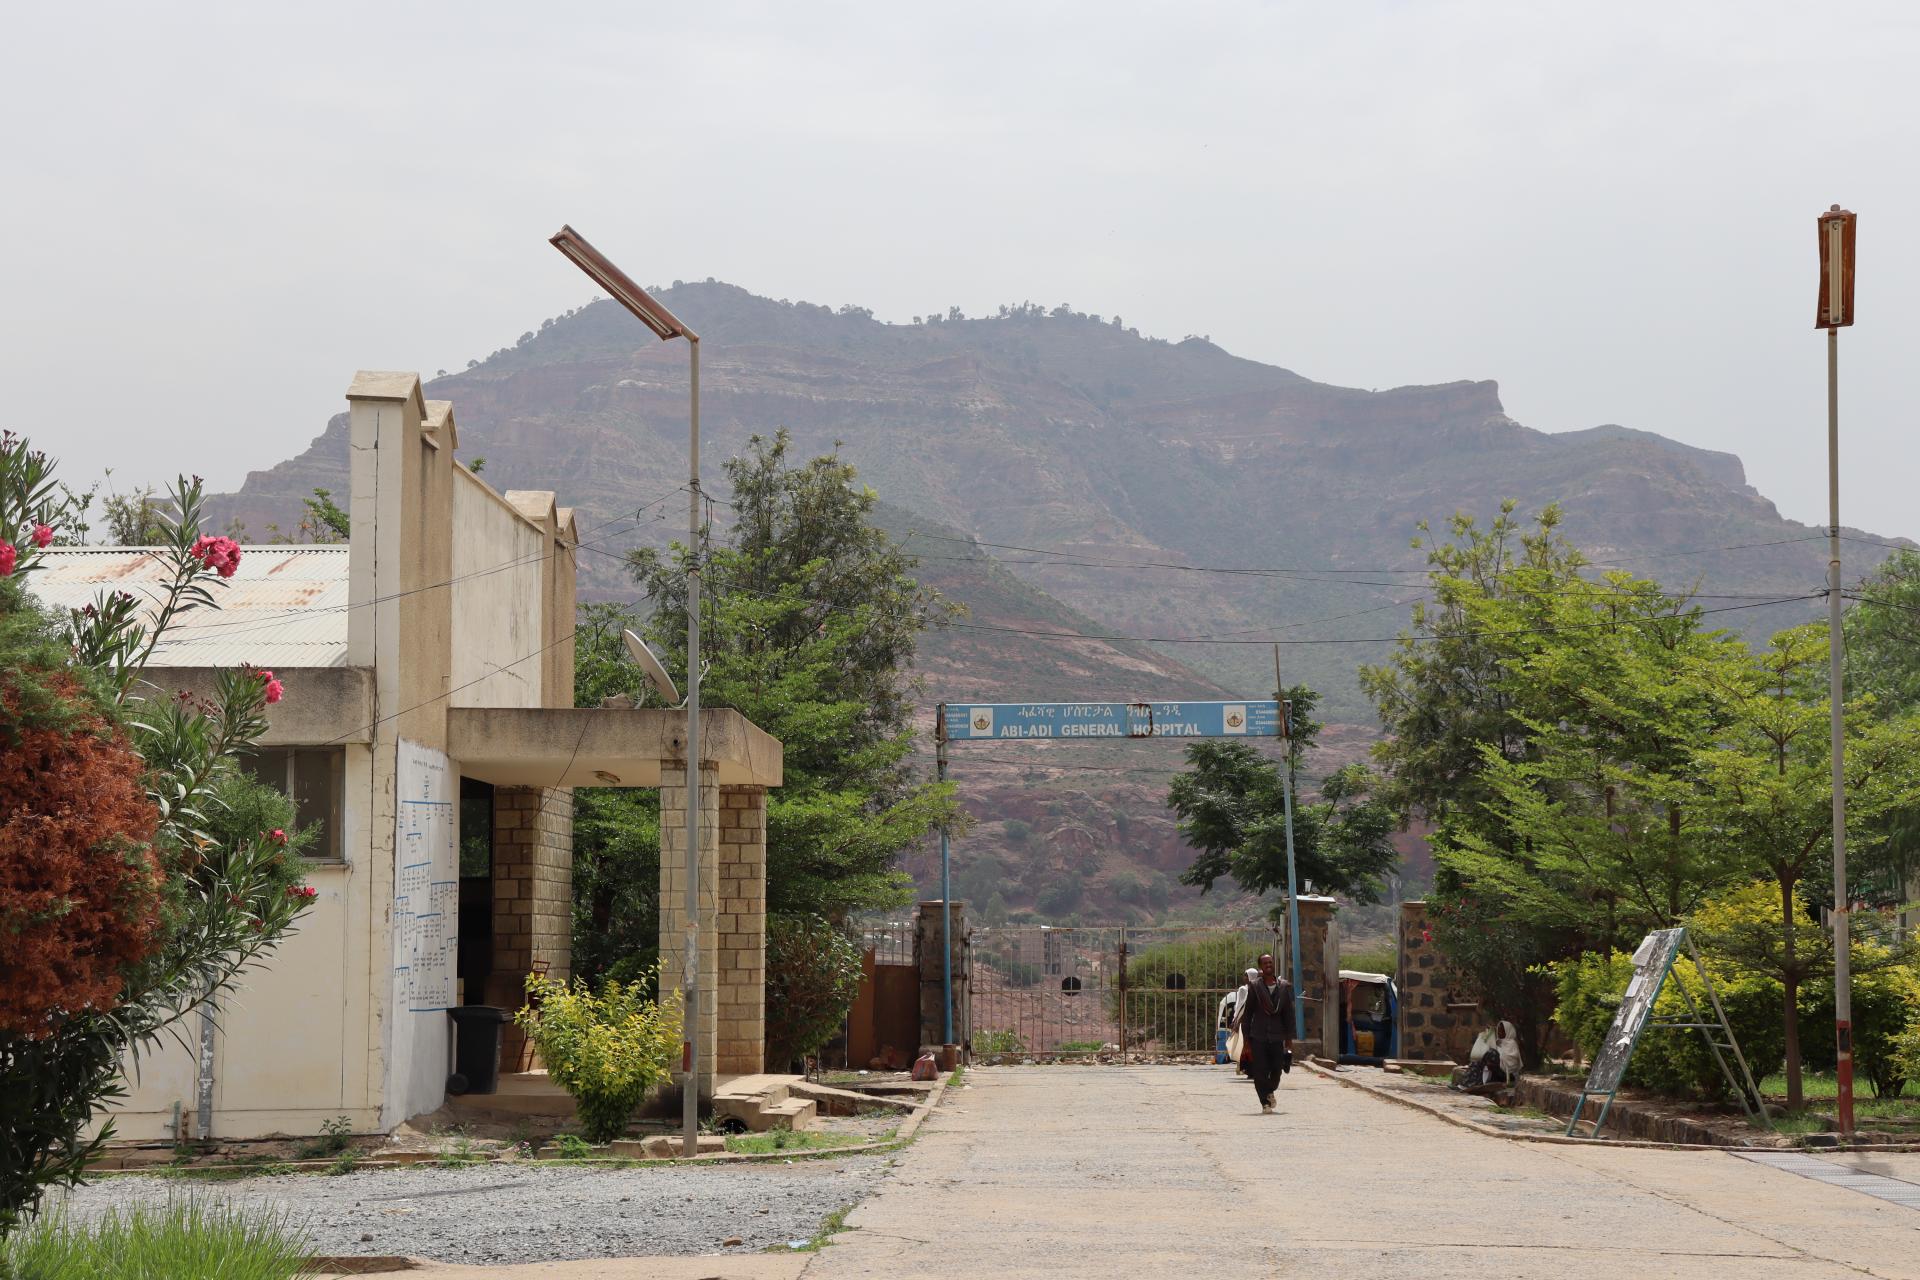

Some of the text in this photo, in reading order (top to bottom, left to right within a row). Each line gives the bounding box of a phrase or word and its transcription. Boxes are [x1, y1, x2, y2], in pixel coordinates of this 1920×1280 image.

[1063, 705, 1113, 718] ሆስፒታል
[1000, 723, 1201, 737] ABI-ADI GENERAL HOSPITAL
